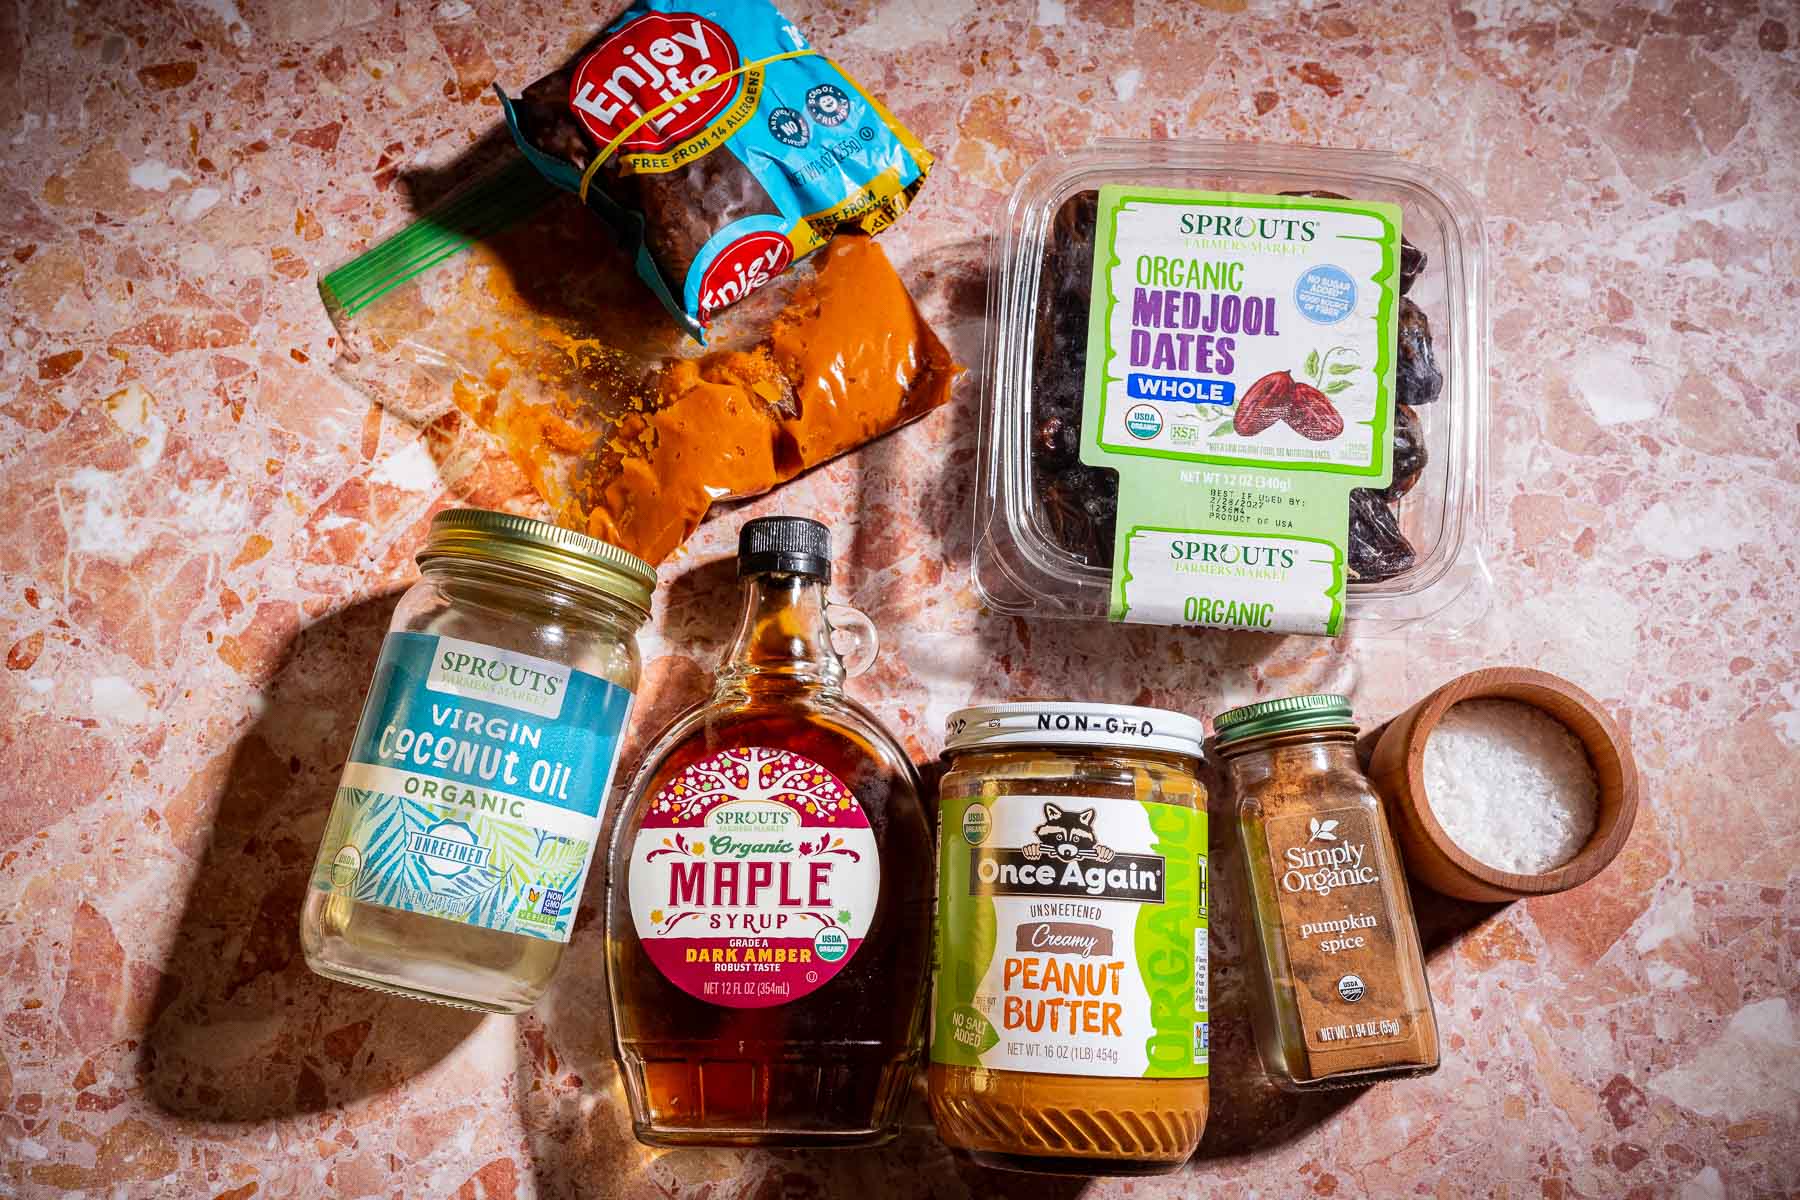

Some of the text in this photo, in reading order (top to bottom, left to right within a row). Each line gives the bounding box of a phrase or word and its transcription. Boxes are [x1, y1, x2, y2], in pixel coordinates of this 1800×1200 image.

[573, 21, 711, 125] Enjoy
[630, 64, 721, 135] Life
[808, 86, 834, 104] SCHOOL
[632, 70, 760, 169] FREE FROM 14 ALLERGENS
[816, 98, 848, 125] FRIENDLY
[780, 120, 798, 136] NO
[843, 189, 877, 218] FROM
[1179, 213, 1316, 241] SPROUTS
[1135, 254, 1245, 292] ORGANIC
[1131, 287, 1280, 336] MEDJOOL
[1130, 329, 1235, 375] DATES
[1137, 377, 1225, 401] WHOLE
[1134, 412, 1155, 421] USDA
[1180, 471, 1200, 484] NET
[1203, 472, 1220, 485] WT
[1239, 474, 1253, 487] OZ
[1210, 488, 1234, 497] BEST
[1241, 492, 1252, 500] IF
[1258, 494, 1282, 503] USED
[1209, 513, 1251, 522] PRODUCT
[1275, 519, 1293, 528] USA
[1171, 540, 1294, 568] SPROUTS
[1175, 562, 1288, 581] FARMERS MARKET
[1184, 596, 1274, 628] ORGANIC
[441, 651, 559, 696] SPROUTS
[432, 703, 542, 749] VIRGIN
[1037, 714, 1153, 737] NON-GMO
[404, 777, 526, 818] ORGANIC
[716, 811, 789, 824] SPROUTS
[968, 812, 984, 823] USDA
[413, 836, 483, 865] UNREFINED
[710, 835, 794, 858] Organic
[1285, 840, 1365, 871] Simply
[668, 862, 834, 907] MAPLE
[977, 858, 1157, 894] Once Again
[545, 900, 560, 909] GMO
[547, 891, 562, 901] NON
[1030, 903, 1102, 920] UNSWEETENED
[710, 914, 788, 933] SYRUP
[1300, 913, 1377, 938] pumpkin
[729, 939, 769, 947] GRADE A
[819, 945, 843, 953] ORGANIC
[822, 935, 842, 943] USDA
[1031, 924, 1098, 958] Creamy
[1320, 935, 1365, 954] spice
[685, 949, 812, 963] DARK AMBER
[714, 963, 781, 972] ROBUST TASTE
[1003, 955, 1125, 997] PEANUT
[704, 982, 719, 995] NET
[721, 983, 731, 995] 12
[732, 983, 742, 995] FL
[744, 982, 755, 995] OZ
[952, 1011, 987, 1035] NO SALT
[1003, 995, 1123, 1037] BUTTER
[953, 1027, 981, 1048] ADDED
[1321, 1026, 1336, 1041] NET
[1007, 1042, 1023, 1056] NET
[1044, 1045, 1054, 1058] 16
[1056, 1046, 1068, 1059] OZ
[1096, 1047, 1118, 1064] 454g
